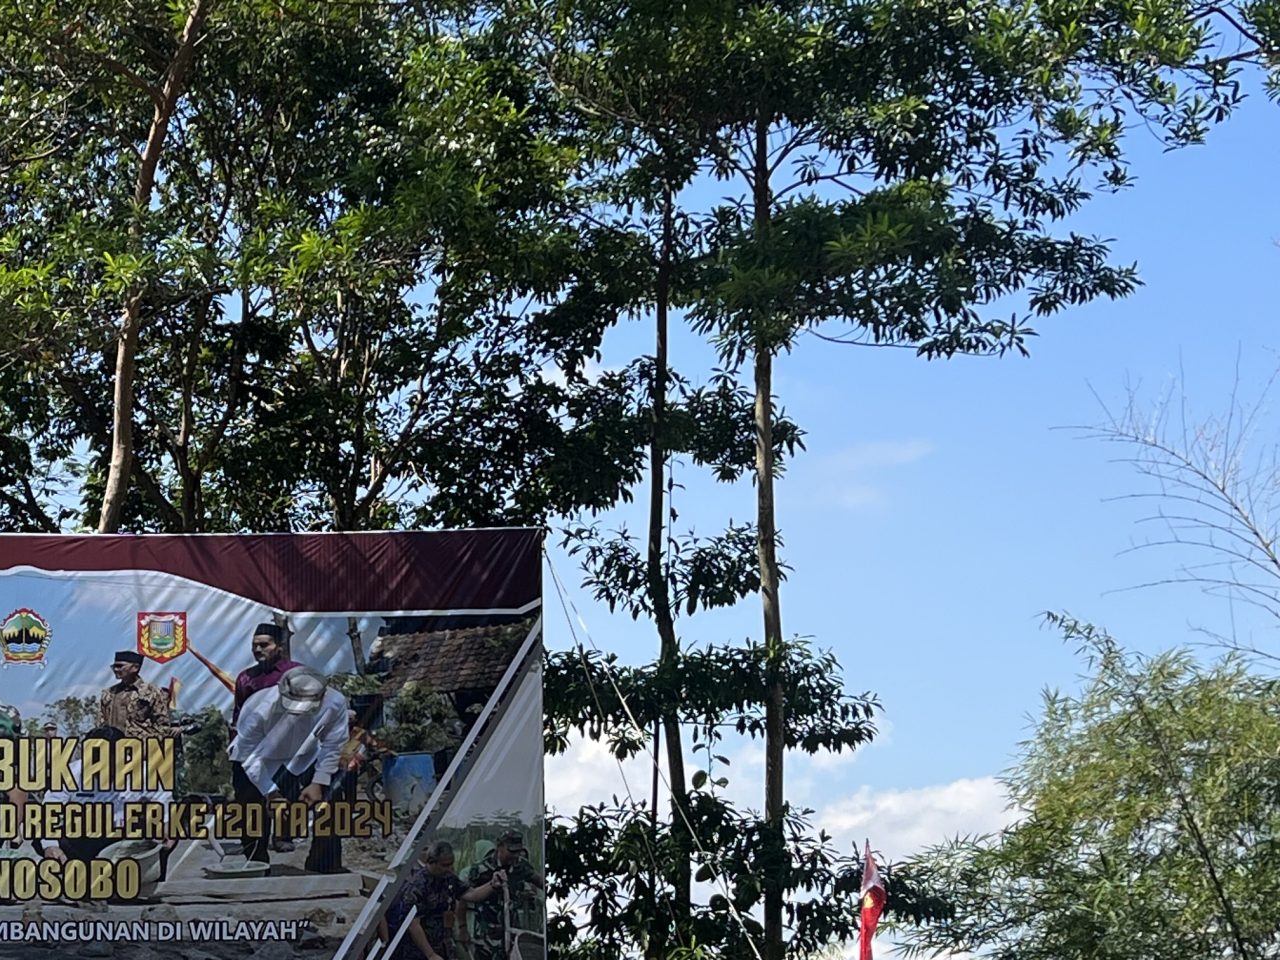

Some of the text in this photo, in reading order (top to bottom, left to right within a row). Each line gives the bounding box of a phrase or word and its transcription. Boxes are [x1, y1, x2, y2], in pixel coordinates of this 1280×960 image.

[24, 803, 165, 839] REGULER
[171, 803, 207, 838] KE
[215, 802, 263, 838] 120
[271, 803, 308, 838] TA
[315, 801, 392, 838] 2024
[157, 921, 182, 941] DI
